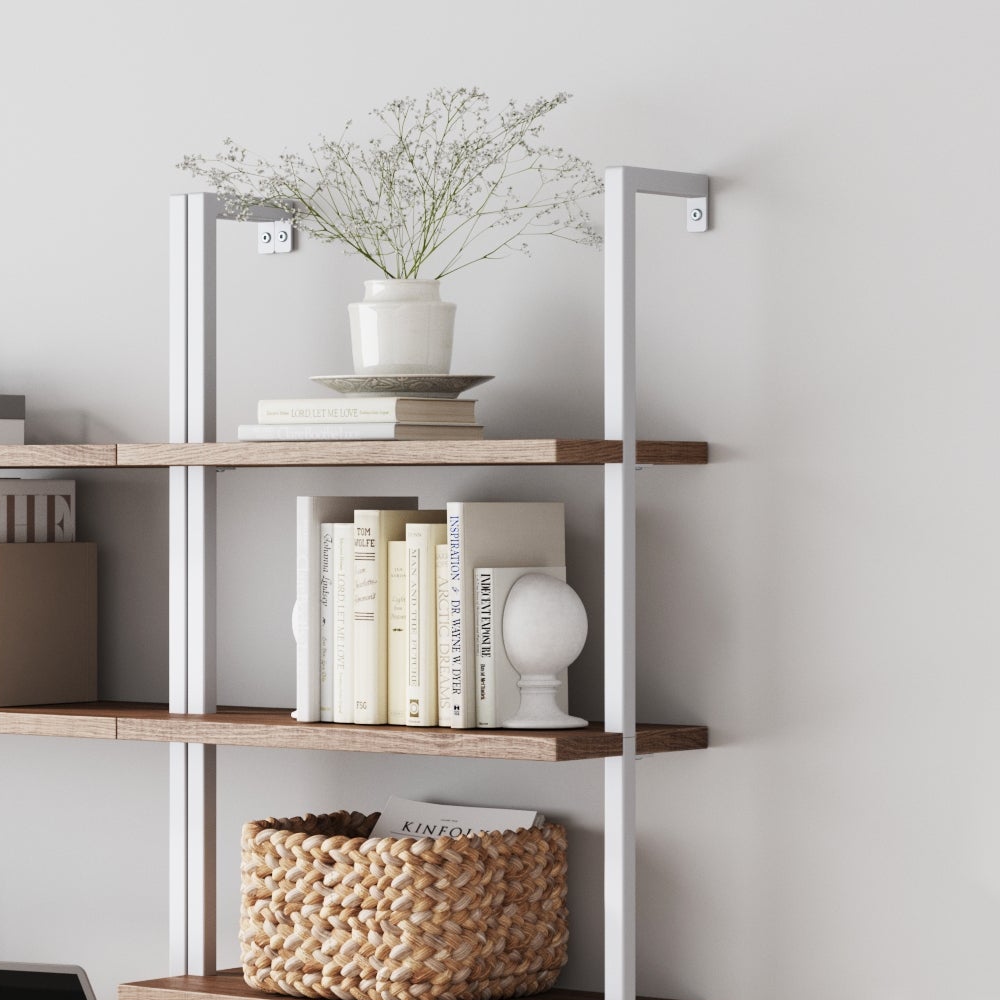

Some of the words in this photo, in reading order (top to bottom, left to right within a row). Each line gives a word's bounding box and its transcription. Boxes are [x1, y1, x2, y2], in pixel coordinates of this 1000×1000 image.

[312, 408, 325, 418] LET
[328, 408, 339, 418] ME
[340, 408, 358, 418] LOVE
[354, 538, 376, 548] WOLFE
[357, 527, 371, 536] TOM
[323, 533, 333, 573] Johanna
[450, 515, 460, 580] INSPIRATION
[321, 575, 332, 607] Lindsey
[480, 573, 491, 616] INDECENT
[337, 605, 345, 624] LET
[438, 576, 451, 638] ARCTIC
[337, 627, 345, 643] ME
[451, 619, 461, 652] WAYNE
[480, 617, 492, 658] EXPOSURE
[337, 644, 345, 670] LOVE
[439, 643, 452, 710] DREAMS
[451, 669, 461, 695] DYER
[402, 821, 490, 838] KINFOL
